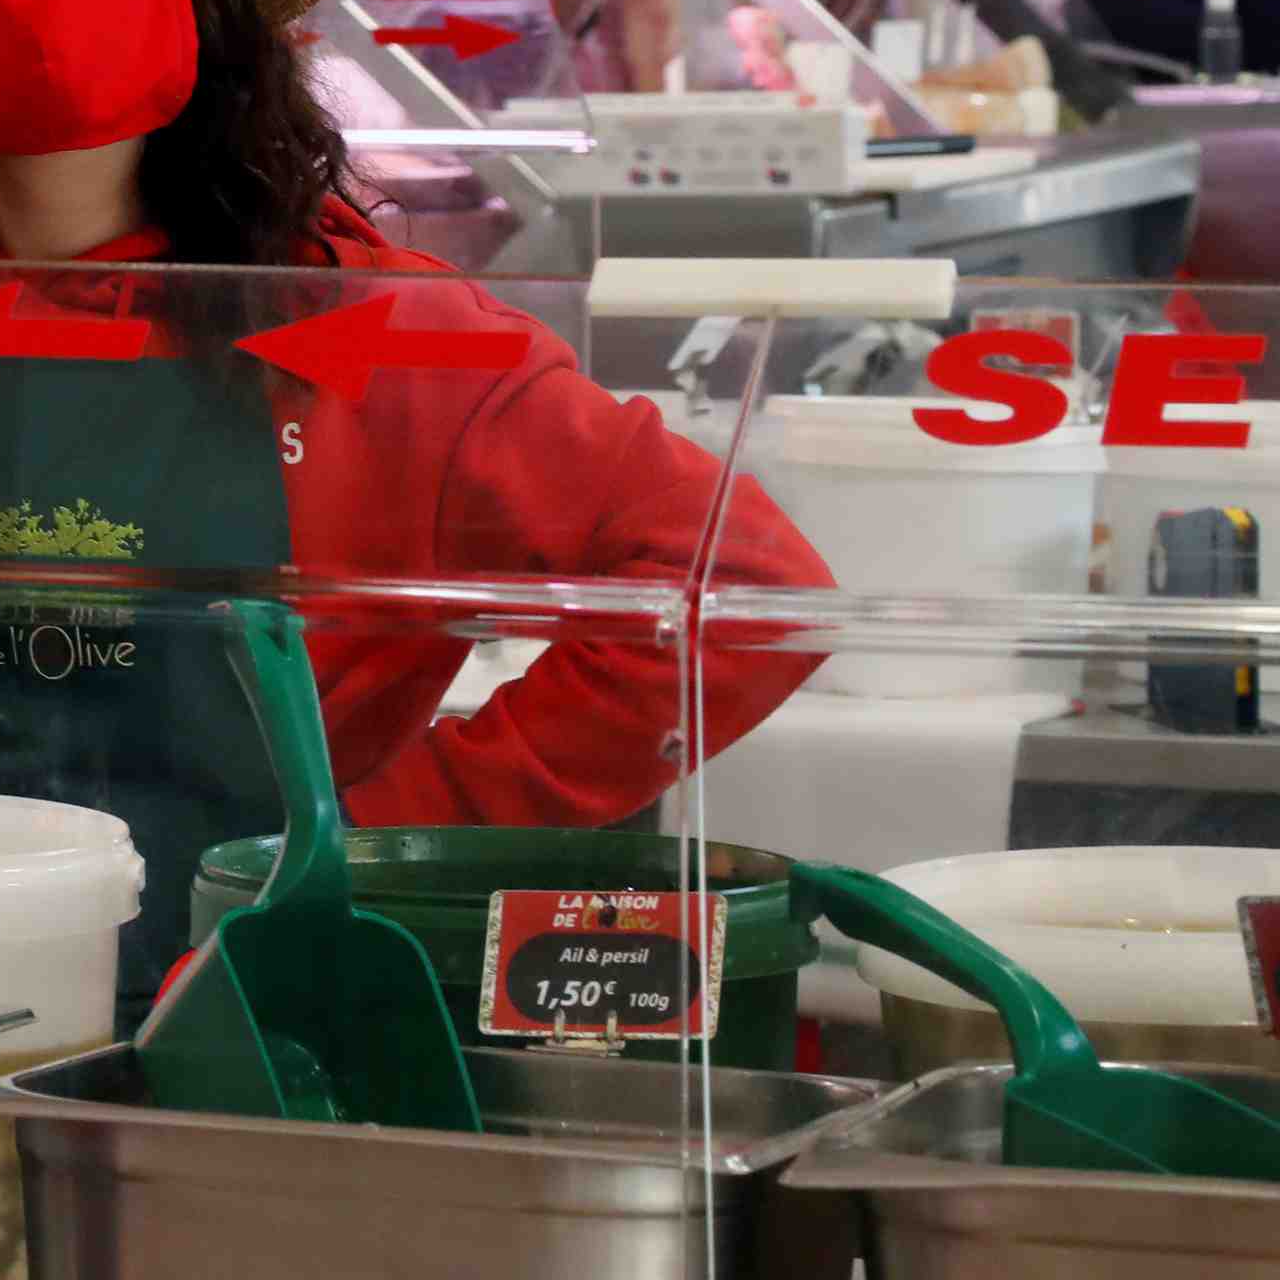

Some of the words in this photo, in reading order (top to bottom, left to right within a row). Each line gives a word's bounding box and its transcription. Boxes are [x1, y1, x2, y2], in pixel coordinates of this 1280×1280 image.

[558, 895, 584, 909] LA
[553, 913, 578, 928] DE
[559, 947, 583, 963] Ail
[584, 948, 601, 963] &
[601, 947, 649, 966] persil
[536, 980, 617, 1010] 1,50€
[629, 992, 670, 1011] 100g
